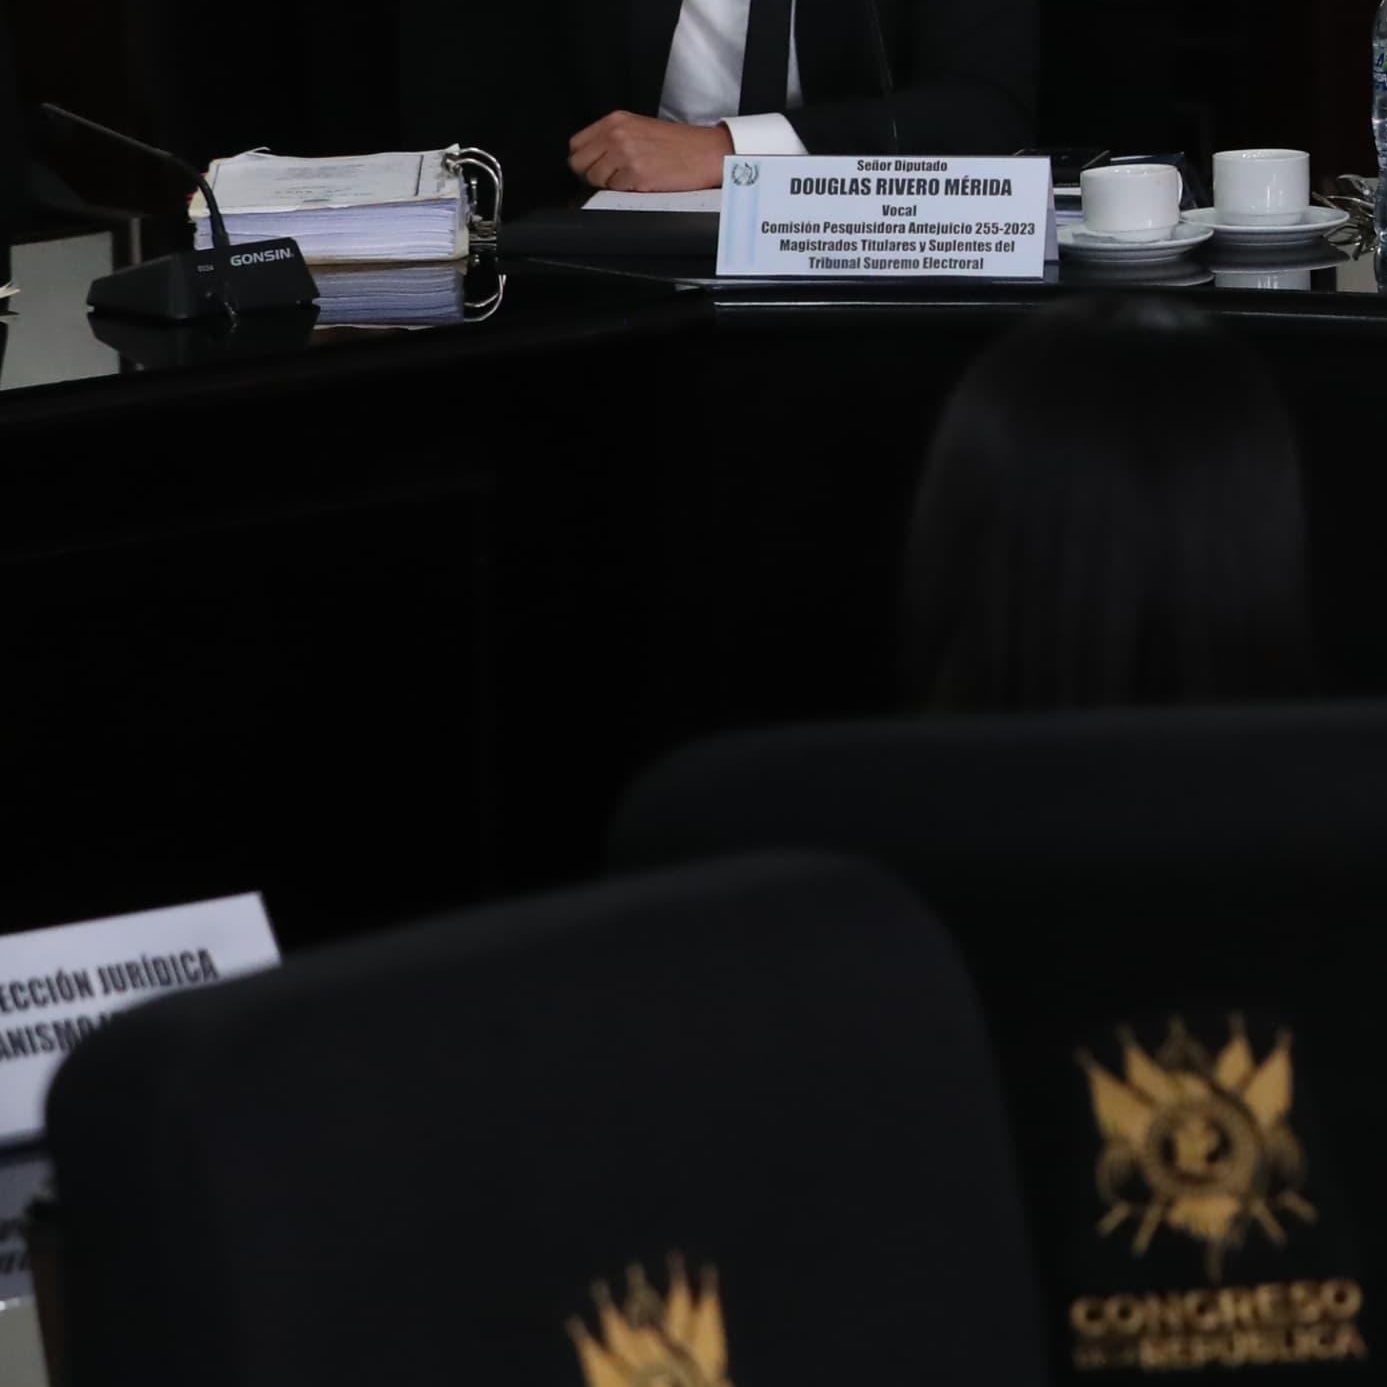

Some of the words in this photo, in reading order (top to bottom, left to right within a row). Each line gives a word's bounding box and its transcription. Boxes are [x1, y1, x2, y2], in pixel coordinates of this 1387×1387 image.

[857, 160, 891, 171] Señor
[894, 160, 947, 173] Diputado
[790, 178, 872, 196] DOUGLAS
[876, 179, 939, 196] RIVERO
[944, 175, 1012, 196] MÉRIDA
[882, 205, 916, 217] Vocal
[761, 221, 820, 234] Comisión
[823, 222, 905, 236] Pesquisidora
[908, 222, 972, 236] Antejuicio
[976, 223, 1035, 235] 255-2023
[780, 239, 857, 254] Magistrados
[861, 240, 916, 252] Titulares
[919, 243, 925, 253] y
[929, 240, 992, 254] Suplentes
[995, 241, 1014, 252] del
[230, 247, 291, 266] GONSIN
[809, 257, 861, 269] Tribunal
[864, 257, 919, 271] Supremo
[923, 257, 984, 270] Electroral
[97, 949, 219, 995] JURÍDICA
